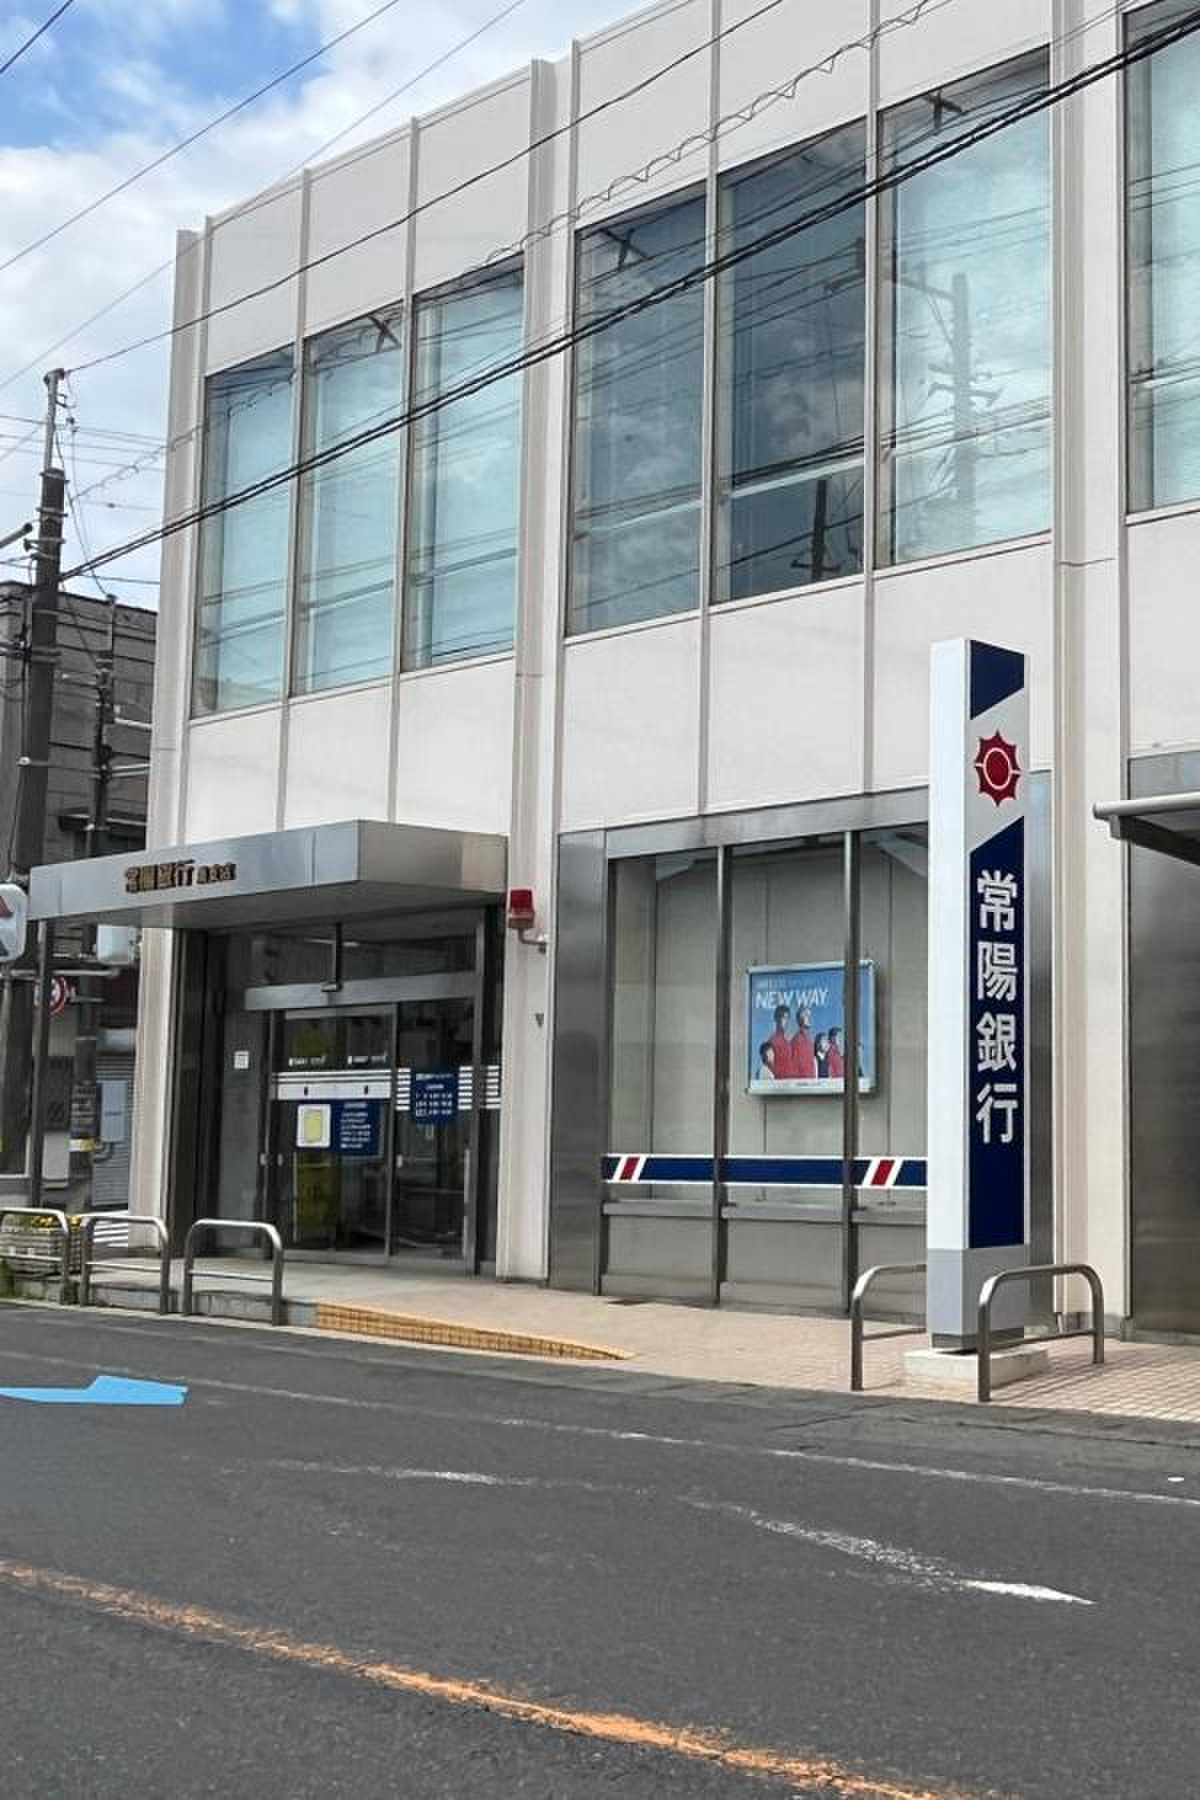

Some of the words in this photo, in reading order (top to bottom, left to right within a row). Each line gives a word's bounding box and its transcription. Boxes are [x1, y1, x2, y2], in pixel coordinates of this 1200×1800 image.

[755, 991, 795, 1009] NEW
[796, 987, 829, 1007] WAY
[976, 870, 1018, 1144] 常陽銀行
